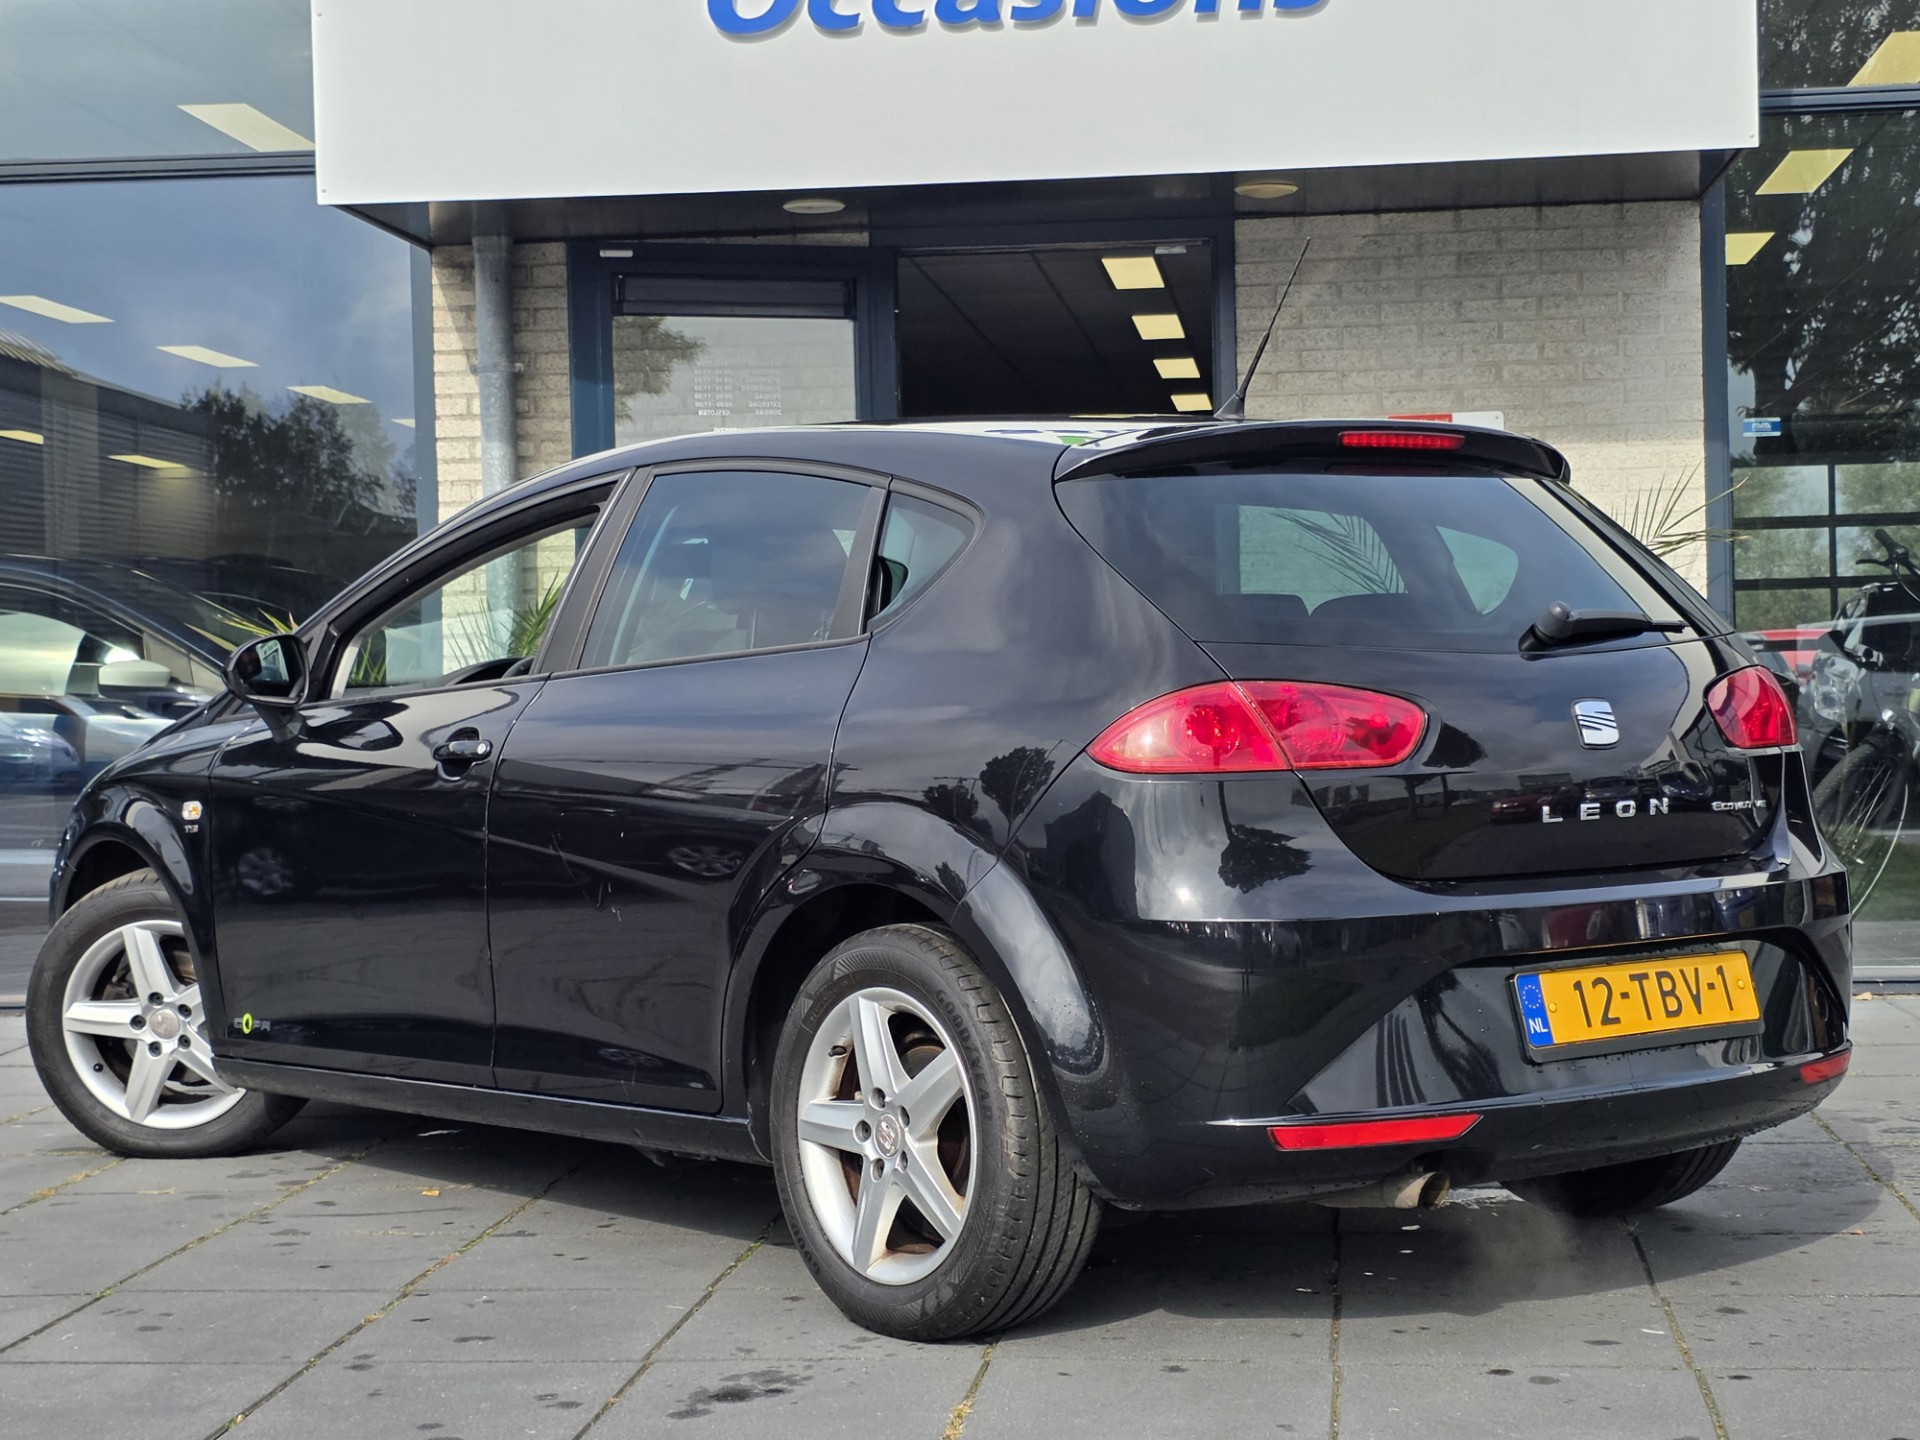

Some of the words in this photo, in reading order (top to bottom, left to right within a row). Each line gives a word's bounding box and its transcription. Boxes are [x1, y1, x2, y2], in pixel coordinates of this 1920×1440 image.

[1542, 797, 1670, 824] LEON
[1572, 964, 1735, 1028] 12-TBV-1
[1528, 1017, 1549, 1035] NL
